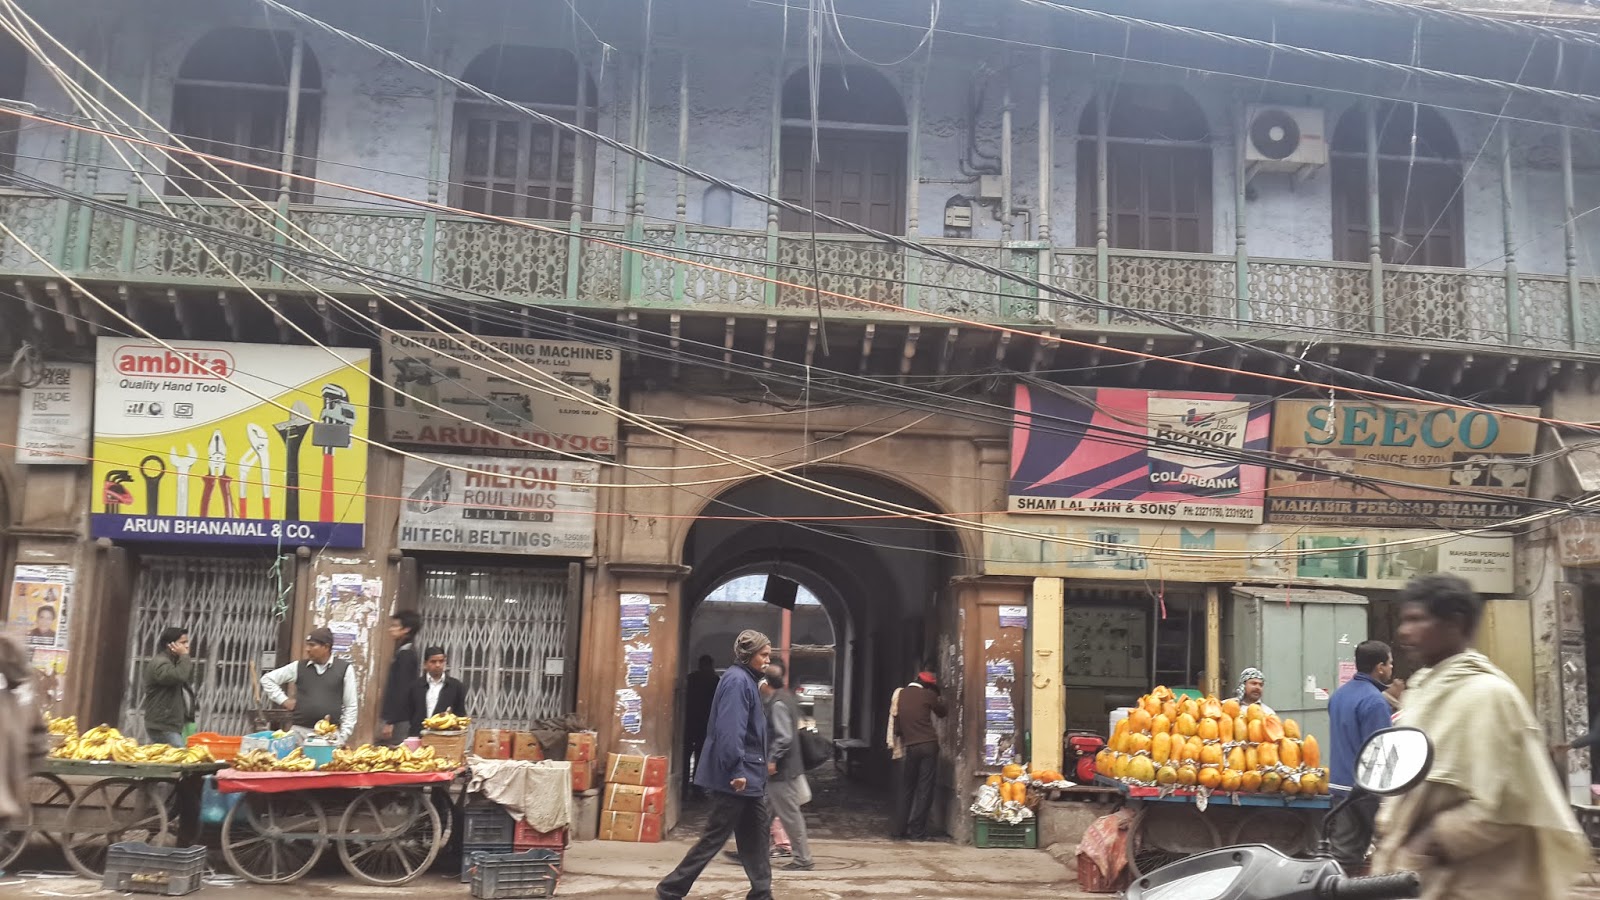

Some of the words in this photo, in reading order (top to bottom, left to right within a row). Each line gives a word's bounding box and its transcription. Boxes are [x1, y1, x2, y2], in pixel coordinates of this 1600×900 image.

[390, 335, 465, 351] PORTABLE
[470, 340, 535, 356] FOGGING
[539, 345, 613, 361] MACHINES
[119, 351, 228, 377] ambika
[119, 379, 160, 392] Quality
[162, 382, 192, 392] Hand
[195, 382, 227, 393] Tools
[33, 392, 71, 402] TRADE
[1304, 405, 1500, 450] SEECO
[418, 425, 500, 446] ARUN
[510, 431, 609, 452] UDYOG
[465, 463, 558, 491] HILTON
[1150, 471, 1238, 489] COLORBANK
[463, 489, 557, 509] ROULUNDS
[1017, 498, 1057, 511] SHAM
[1061, 500, 1085, 511] LAL
[1089, 502, 1122, 512] JAIN
[1125, 503, 1135, 513] &
[1139, 503, 1177, 515] SONS
[1271, 500, 1352, 514] MAHABIR
[1438, 503, 1487, 517] SHAM
[1490, 505, 1521, 518] LAL
[464, 509, 552, 522] LIMITED
[123, 518, 169, 533] ARUN
[174, 520, 267, 537] BHANAMAL
[270, 524, 282, 537] &
[286, 525, 315, 539] CO.
[401, 526, 464, 543] HITECH
[468, 529, 551, 547] BELTINGS
